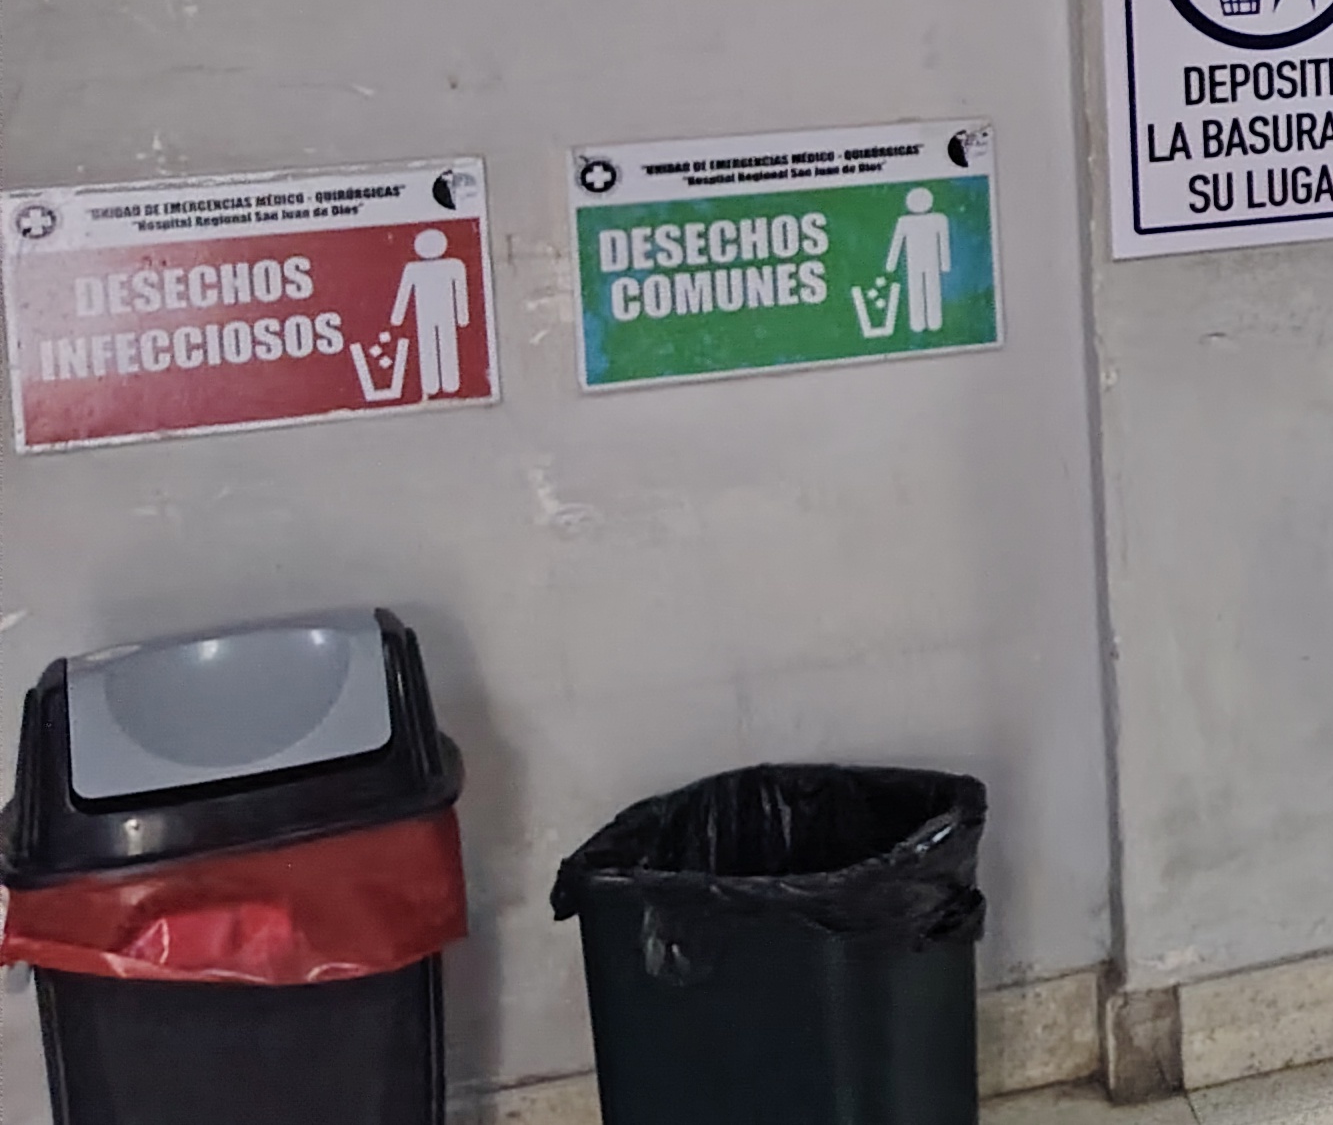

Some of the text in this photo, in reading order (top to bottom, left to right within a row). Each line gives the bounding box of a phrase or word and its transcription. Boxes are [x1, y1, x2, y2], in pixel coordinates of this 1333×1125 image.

[1147, 122, 1192, 163] LA
[144, 203, 159, 217] DE
[163, 196, 253, 215] EMERGENCIAS
[1188, 172, 1234, 214] SU
[599, 212, 829, 273] DESECHOS
[75, 256, 314, 318] DESECHOS
[611, 260, 828, 322] COMUNES
[40, 312, 344, 383] INFECCIOSOS
